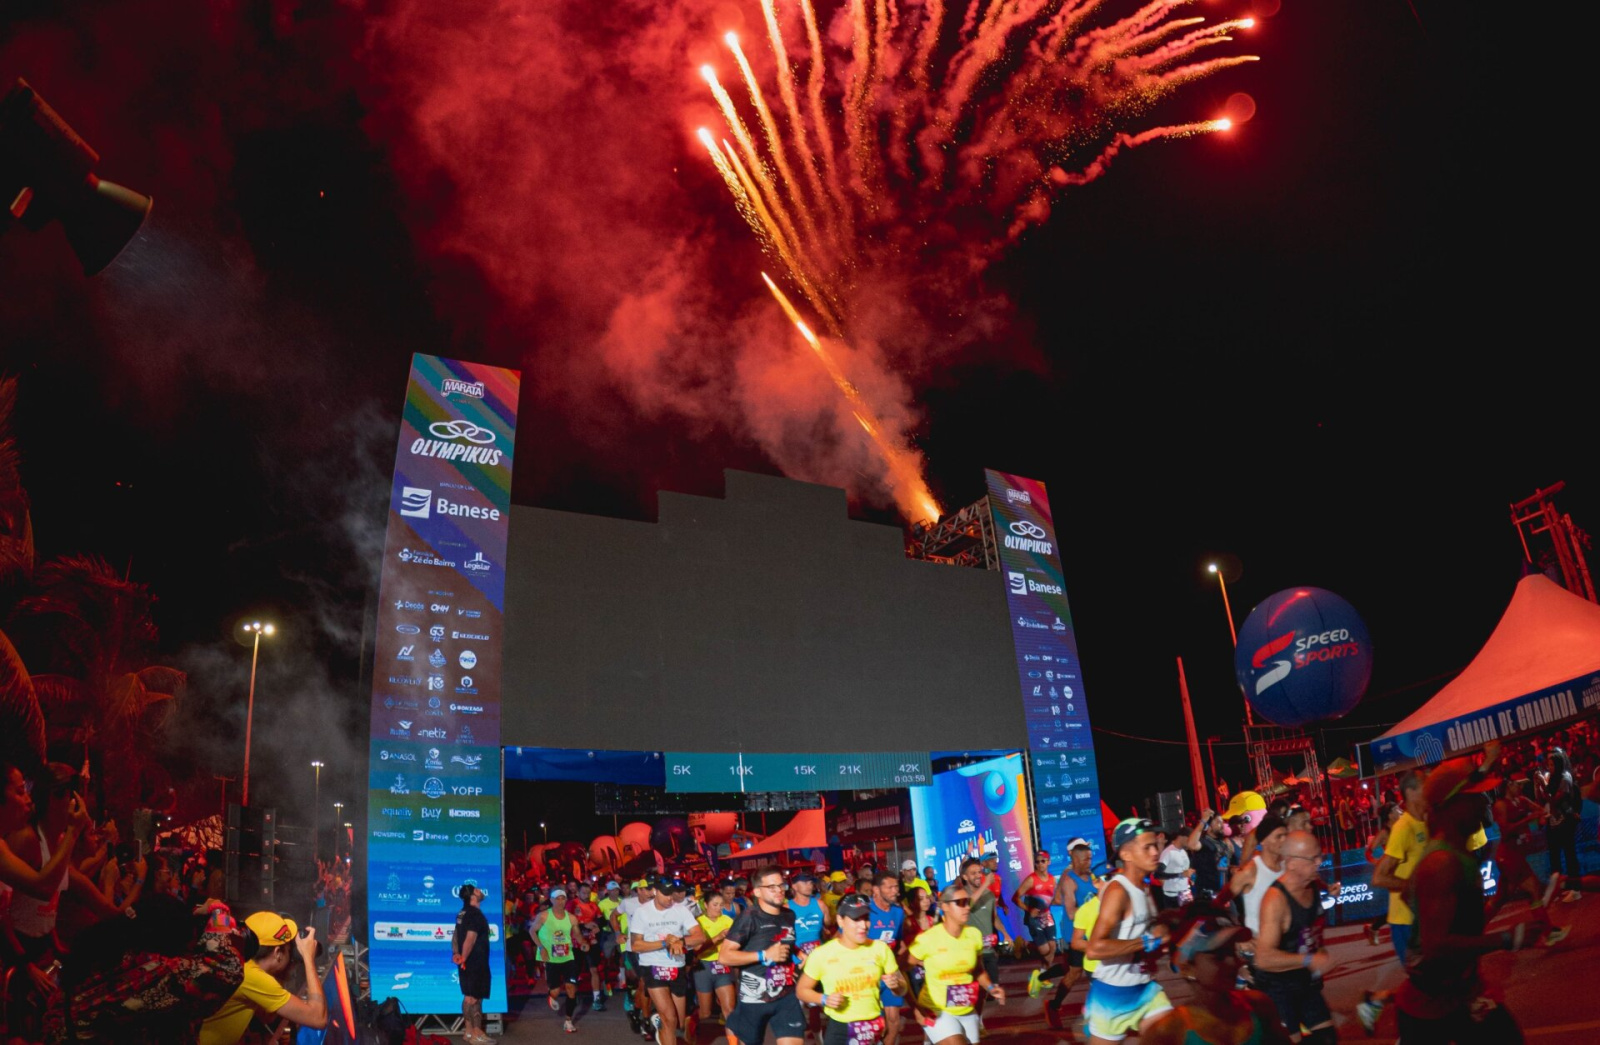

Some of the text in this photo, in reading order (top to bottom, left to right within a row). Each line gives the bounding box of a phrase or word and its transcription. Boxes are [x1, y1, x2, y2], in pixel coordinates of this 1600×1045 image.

[410, 438, 502, 466] OLYMPIKUS
[436, 498, 500, 520] Banese
[1004, 535, 1052, 555] OLYMPIKUS
[1028, 580, 1062, 595] Banese
[1296, 629, 1349, 651] SPEED
[1295, 643, 1358, 669] SPORTS
[1498, 709, 1517, 737] DE
[1516, 689, 1578, 731] CHAMADA
[673, 765, 691, 775] 5K
[794, 765, 816, 775] 15K
[840, 765, 862, 775] 21K
[899, 763, 919, 773] 42K
[894, 775, 926, 783] 0:03:59
[451, 786, 482, 796] YOPP
[1336, 891, 1374, 905] SPORTS
[1339, 884, 1368, 895] SPEED
